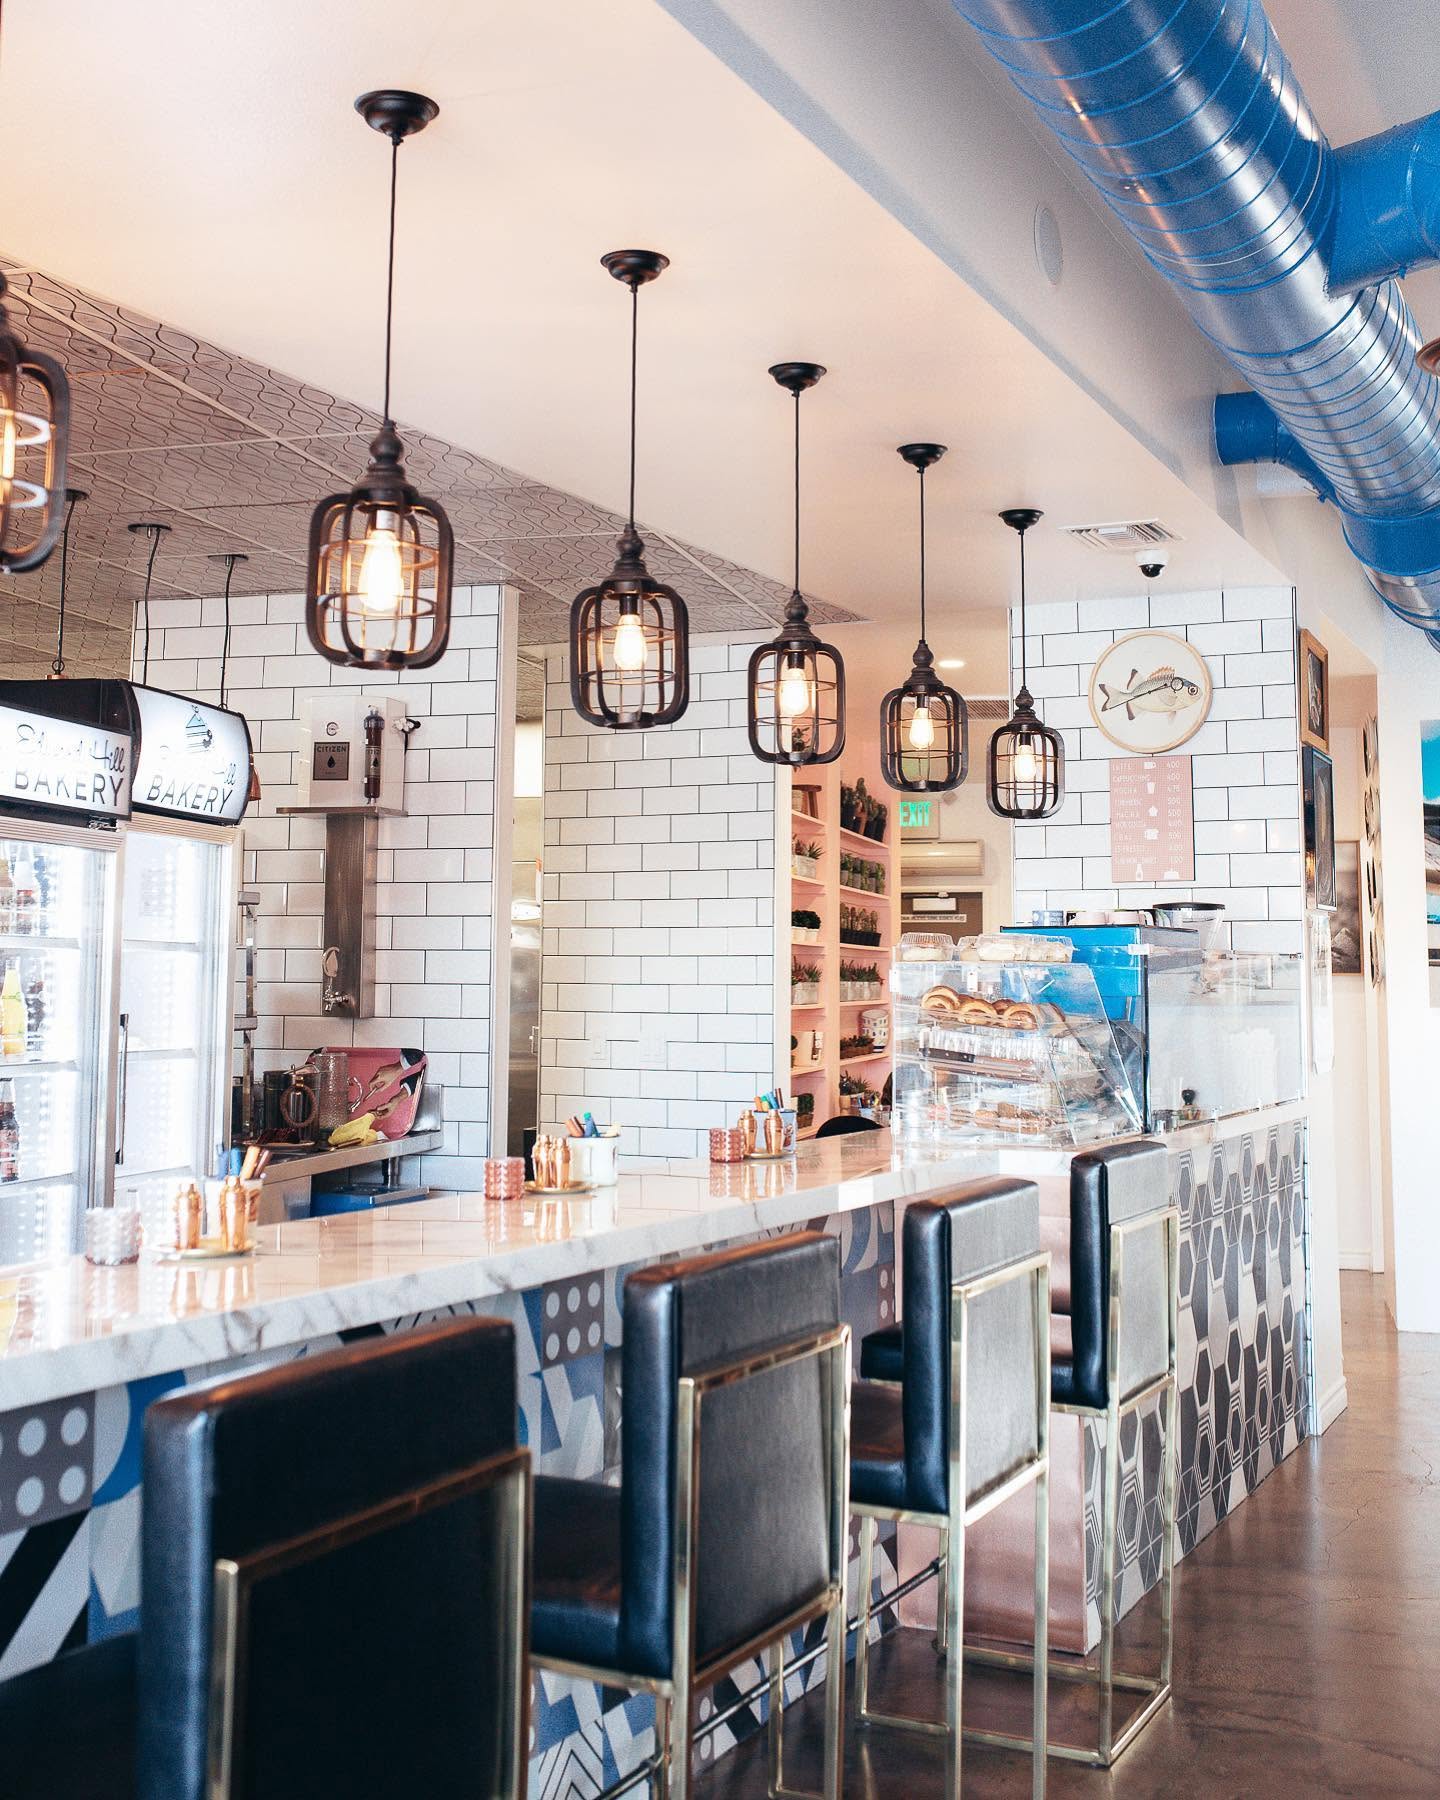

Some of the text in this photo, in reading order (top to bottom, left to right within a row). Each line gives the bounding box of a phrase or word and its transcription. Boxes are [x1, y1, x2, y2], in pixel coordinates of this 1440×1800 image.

[89, 740, 125, 772] Hill
[15, 768, 124, 806] BAKERY
[147, 774, 233, 814] BAKERY
[899, 801, 930, 827] EXIT
